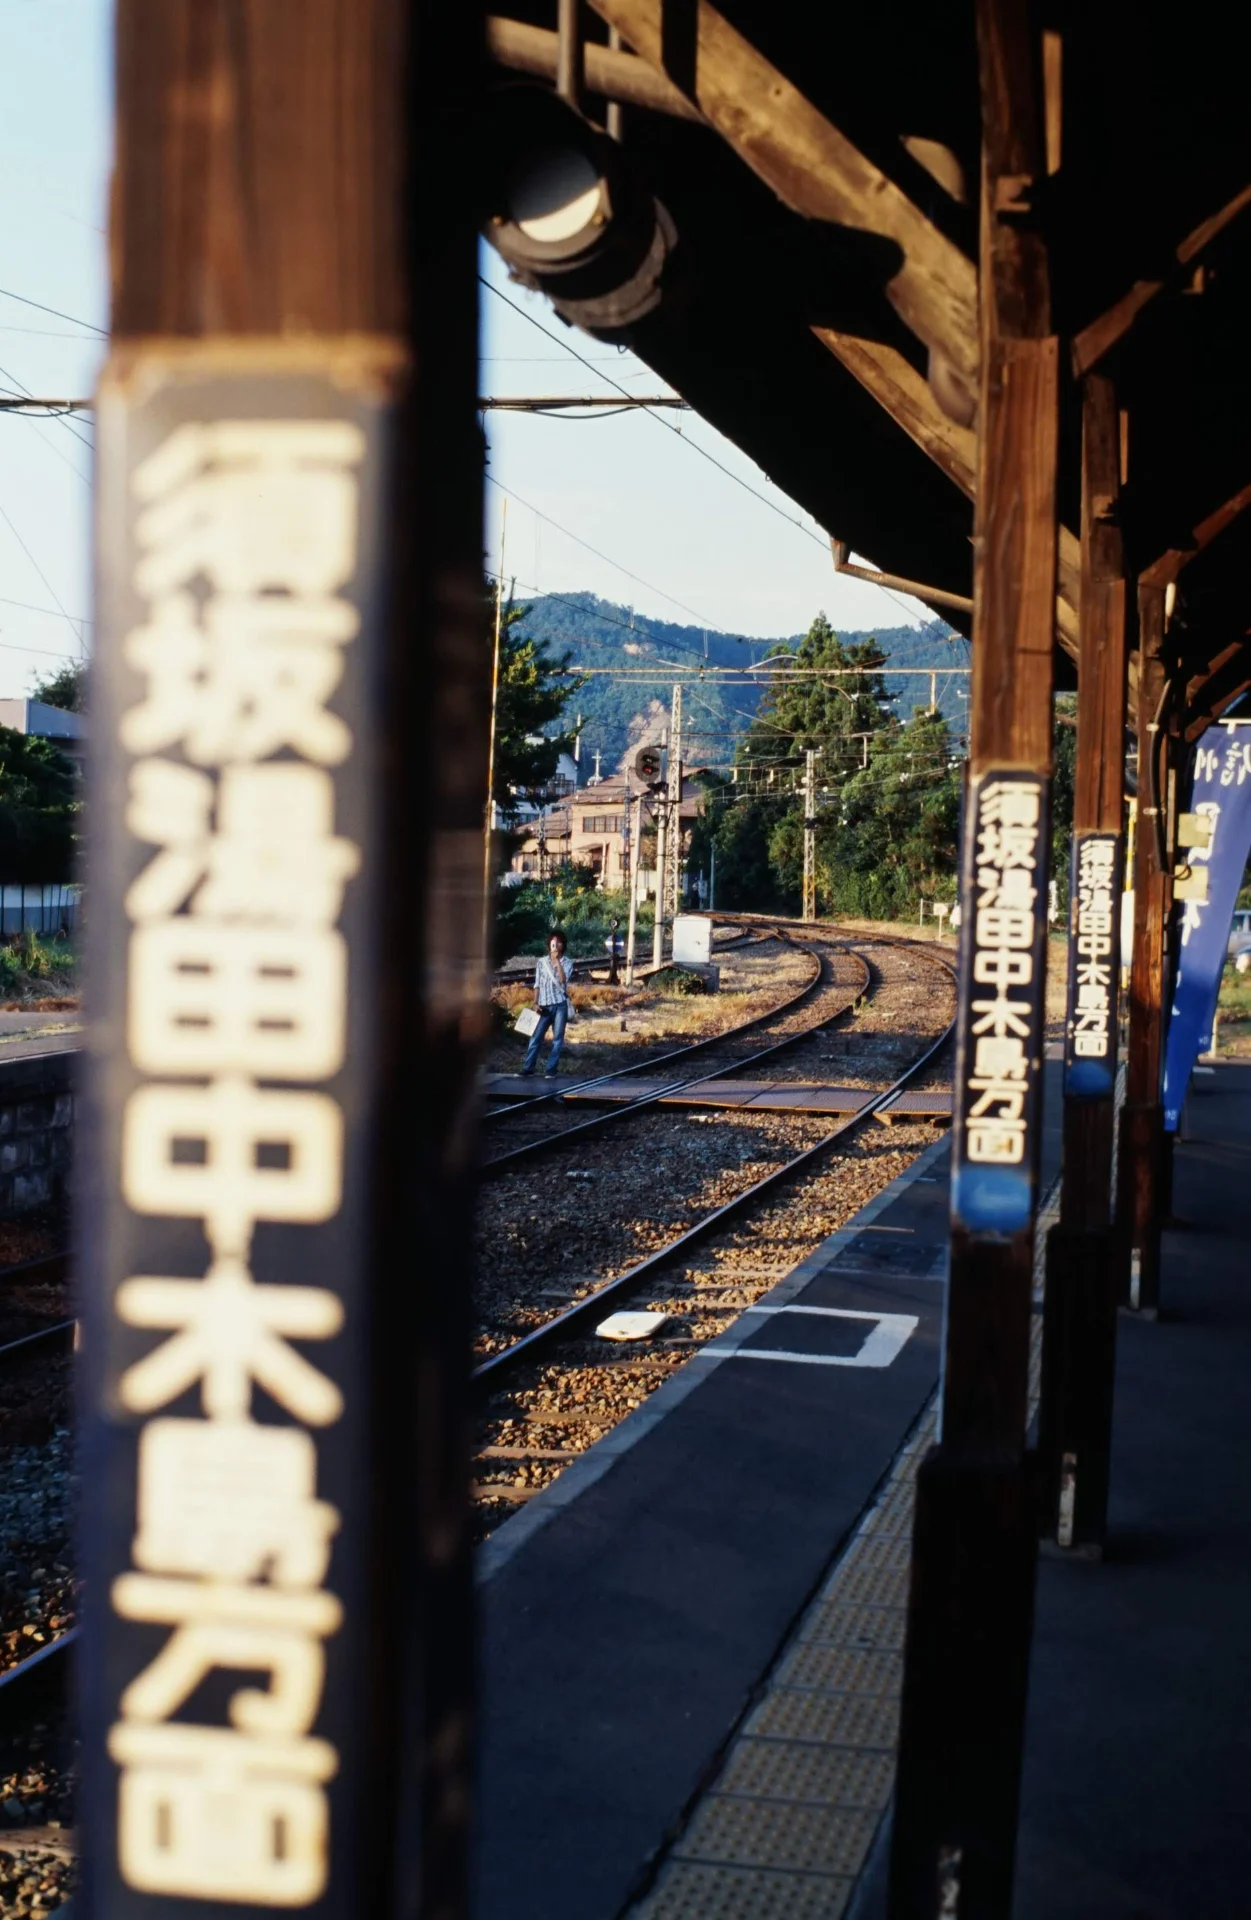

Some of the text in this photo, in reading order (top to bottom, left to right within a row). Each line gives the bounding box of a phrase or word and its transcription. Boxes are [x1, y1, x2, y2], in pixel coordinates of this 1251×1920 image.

[965, 781, 1042, 1164] 須坂湯田中木島方面
